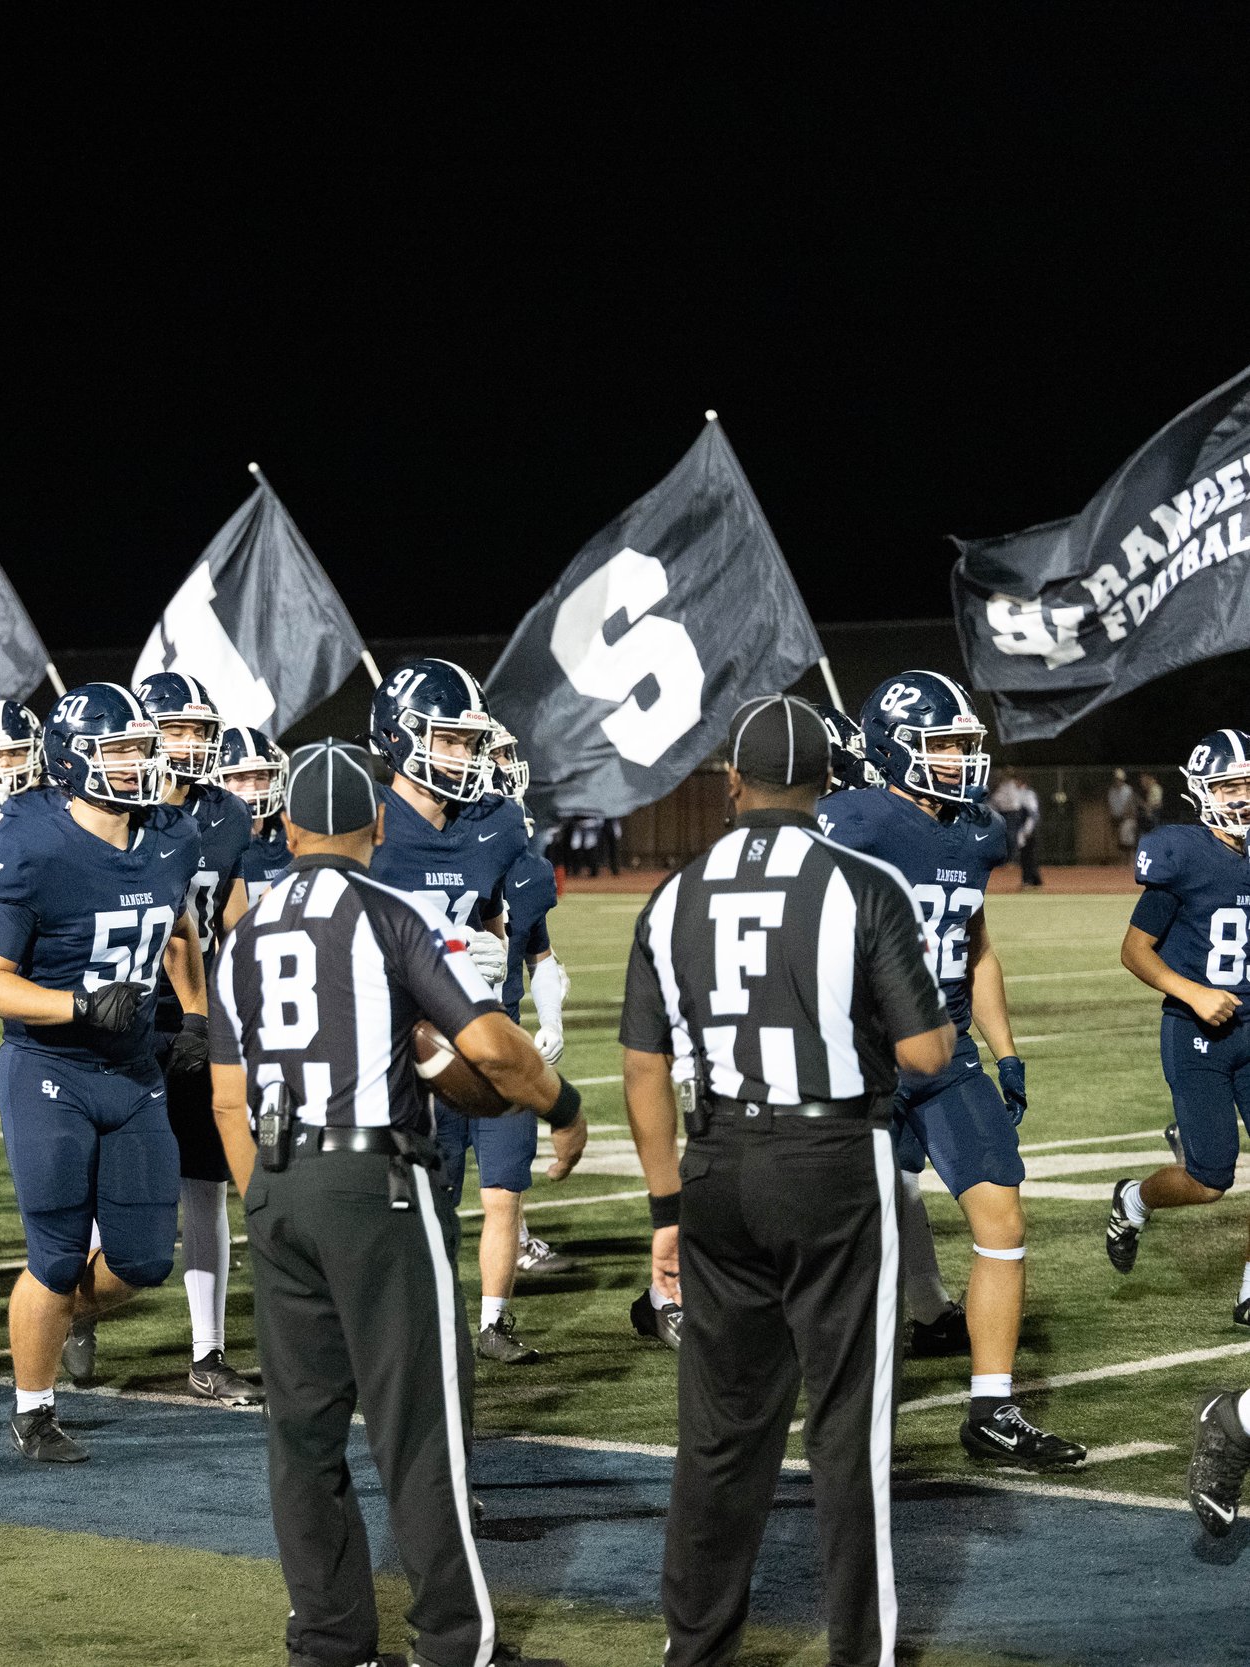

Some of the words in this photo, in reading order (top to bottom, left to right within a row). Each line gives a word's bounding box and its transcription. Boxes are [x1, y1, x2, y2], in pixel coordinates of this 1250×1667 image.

[1080, 452, 1250, 614] RANGE
[550, 547, 705, 766] S
[386, 668, 427, 704] 91
[880, 683, 921, 719] 82
[53, 695, 89, 724] 50
[425, 871, 465, 887] RANGERS
[936, 867, 968, 884] RANGERS
[1137, 850, 1152, 876] SV
[119, 892, 154, 907] RANGERS
[82, 904, 176, 997] 50
[707, 891, 787, 1016] F
[1206, 907, 1250, 986] 8
[253, 930, 318, 1050] B
[1193, 1037, 1209, 1054] SV
[41, 1079, 60, 1099] SV
